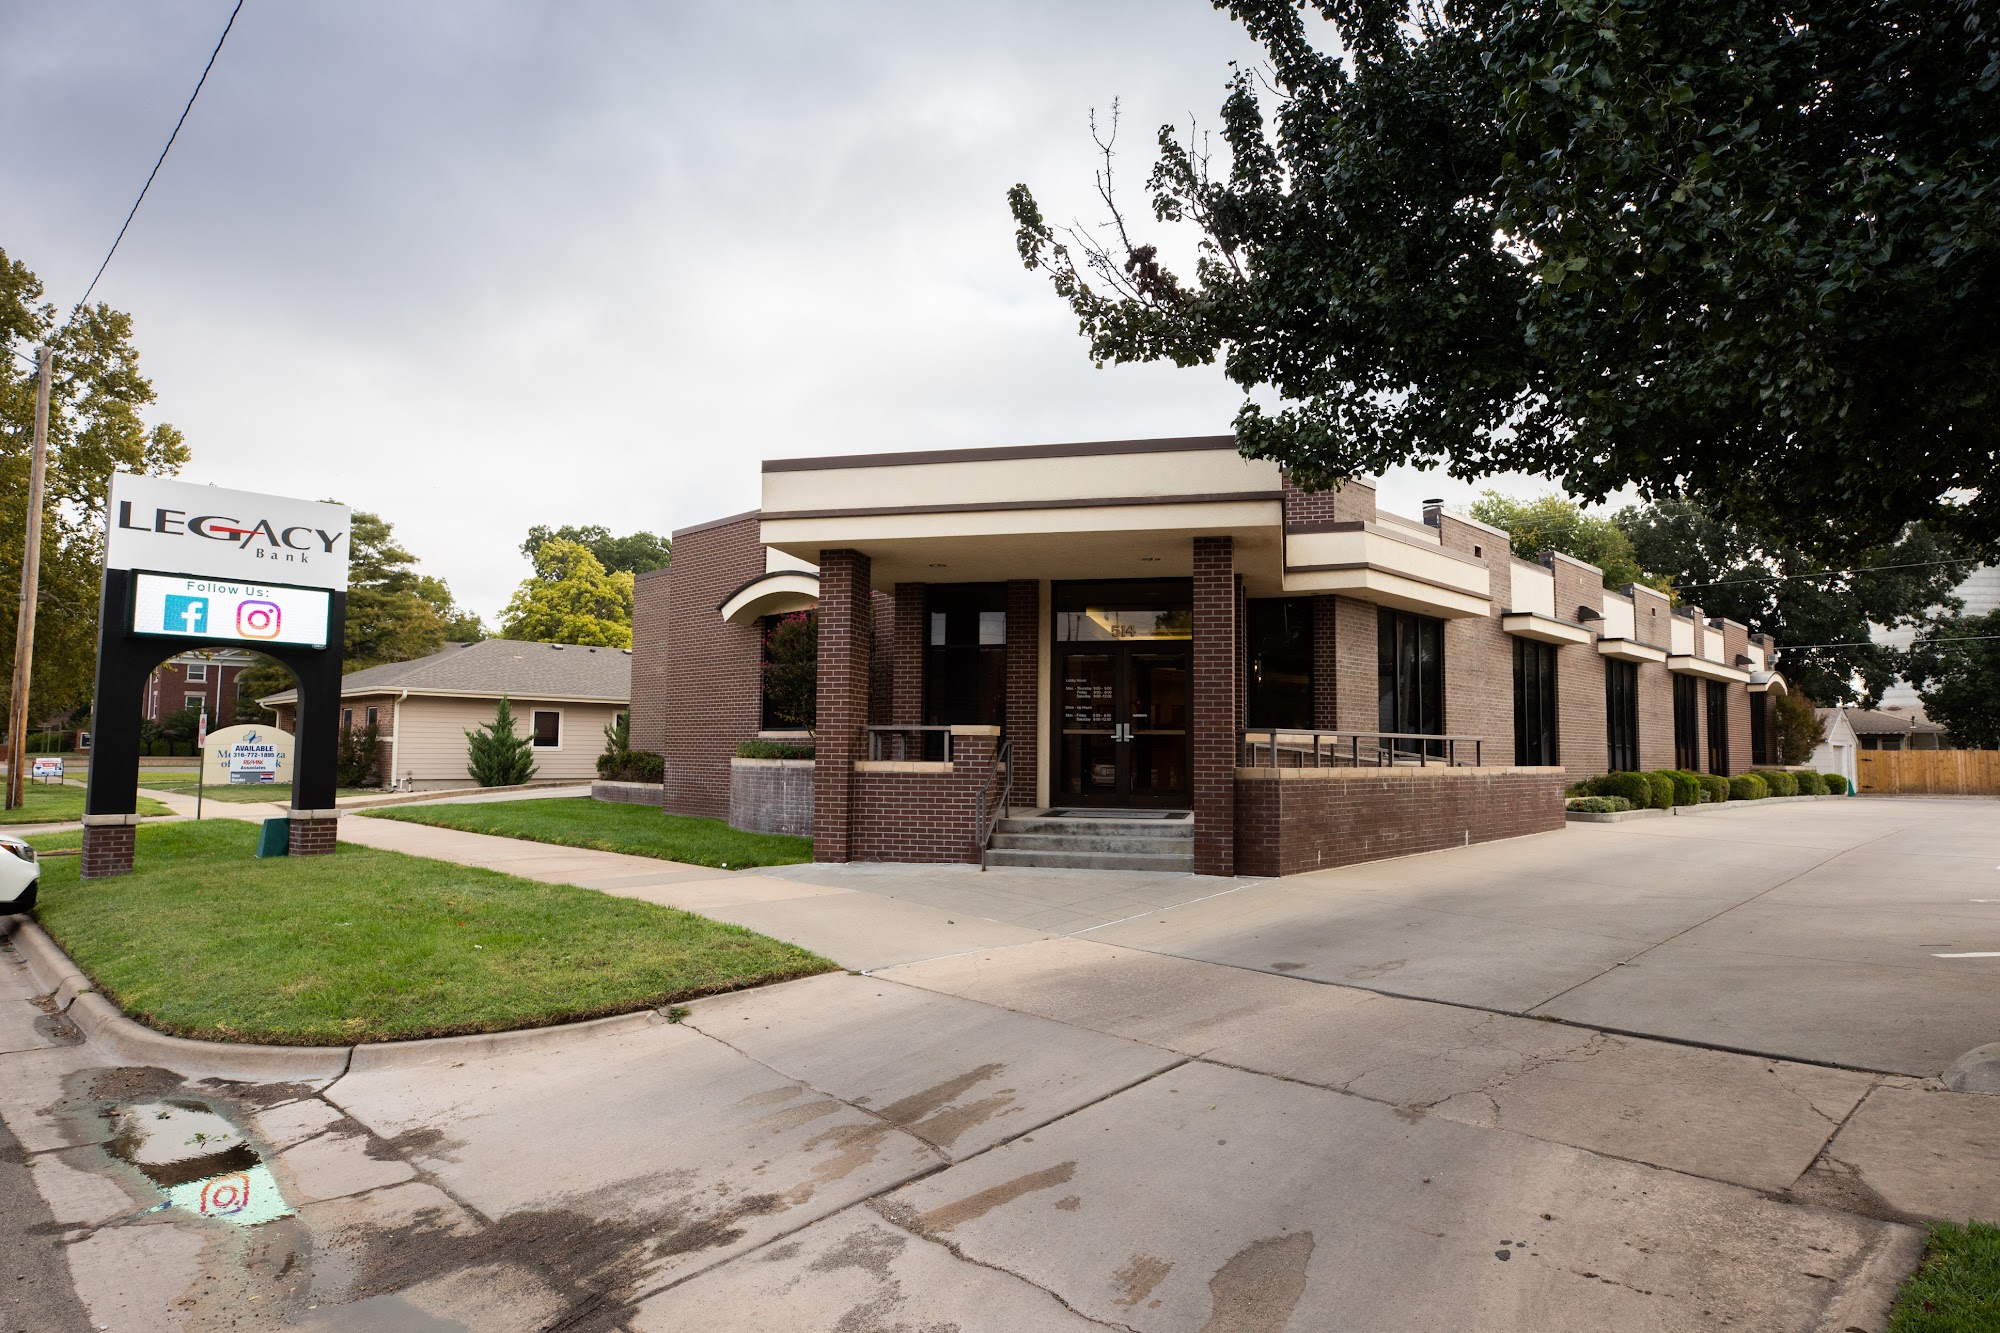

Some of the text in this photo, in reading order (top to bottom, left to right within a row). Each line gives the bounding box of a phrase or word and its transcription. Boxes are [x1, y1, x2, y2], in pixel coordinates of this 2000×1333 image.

[119, 500, 343, 553] LEGACY
[256, 548, 309, 563] Bank
[187, 581, 270, 598] Follow Us:
[1110, 624, 1136, 638] 514
